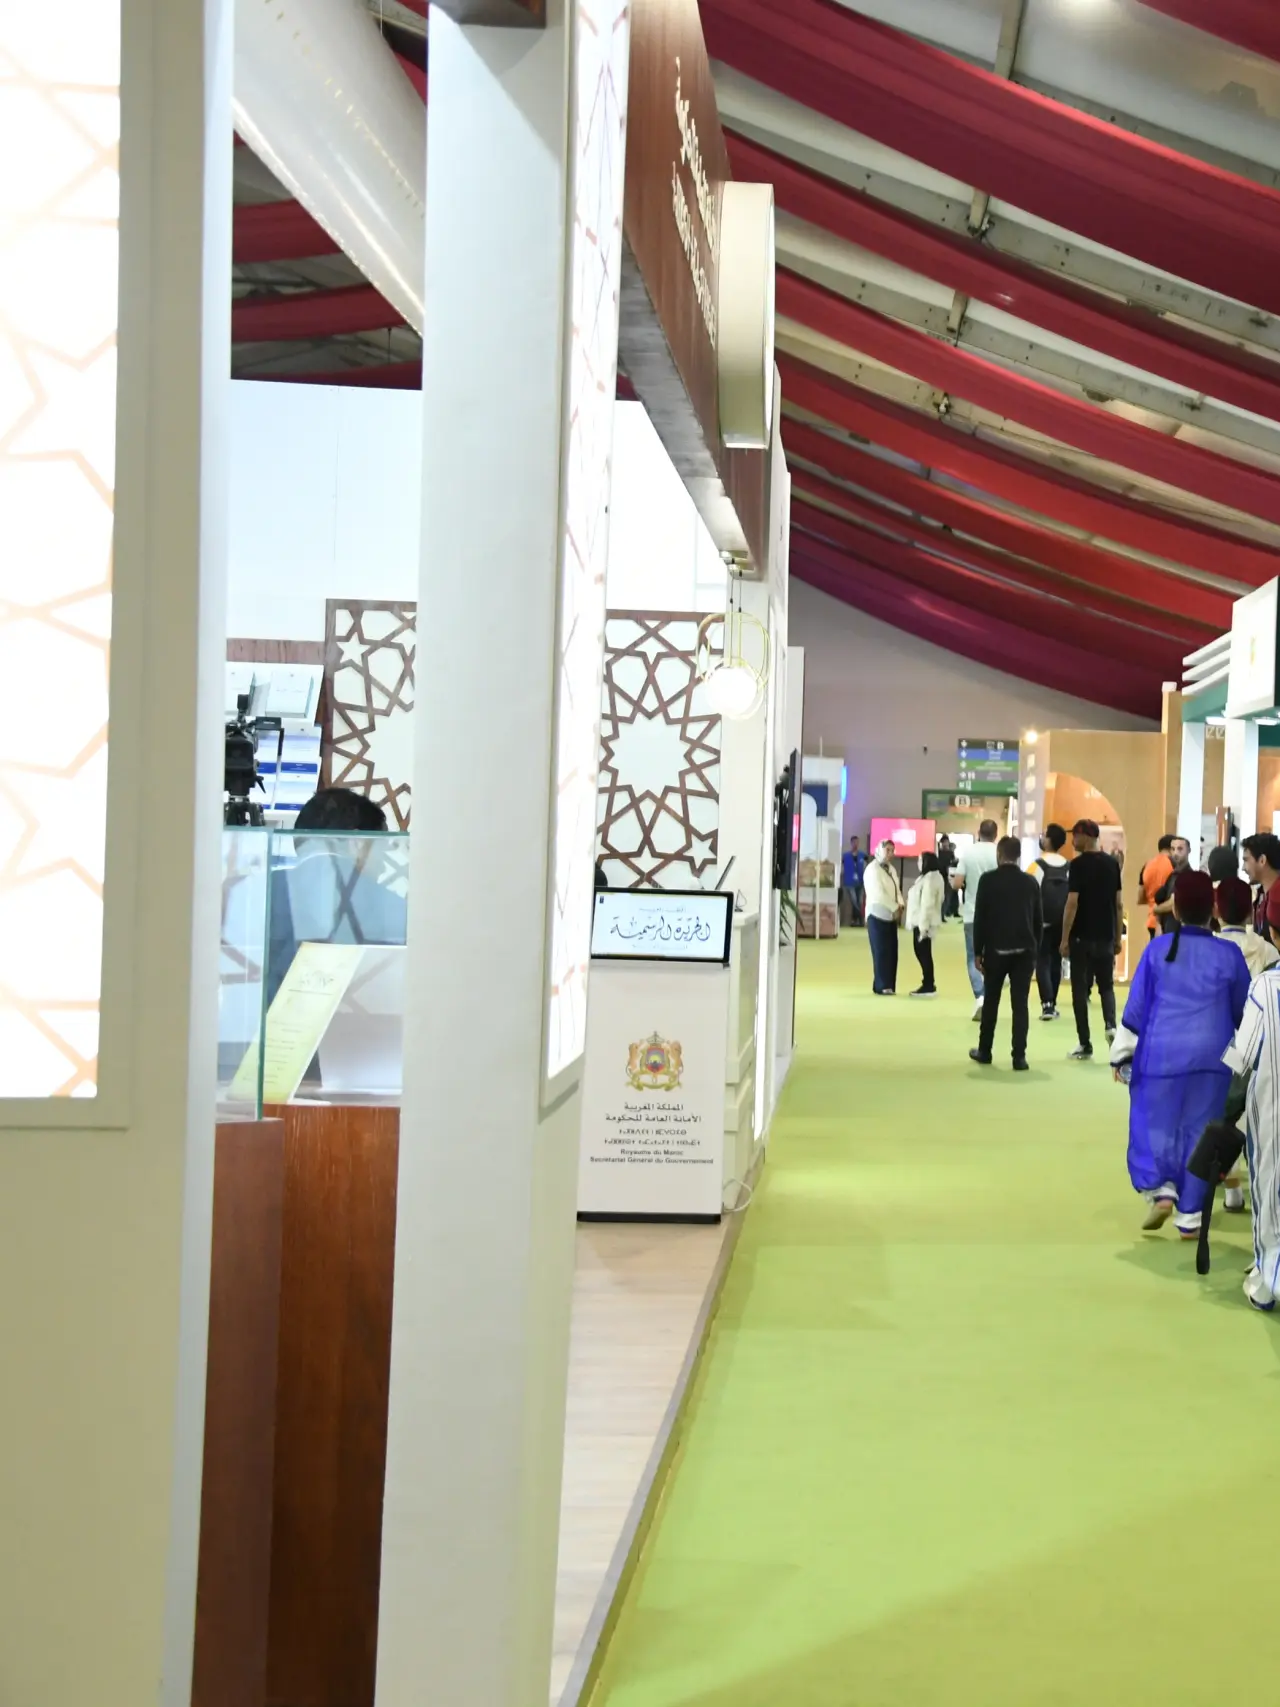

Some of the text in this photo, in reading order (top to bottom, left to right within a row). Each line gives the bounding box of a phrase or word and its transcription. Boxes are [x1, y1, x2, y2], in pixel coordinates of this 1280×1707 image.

[624, 1102, 684, 1112] المملكة المغربية
[605, 1113, 643, 1124] للحكومة
[645, 1114, 671, 1122] العامة
[620, 1148, 651, 1156] Royaume
